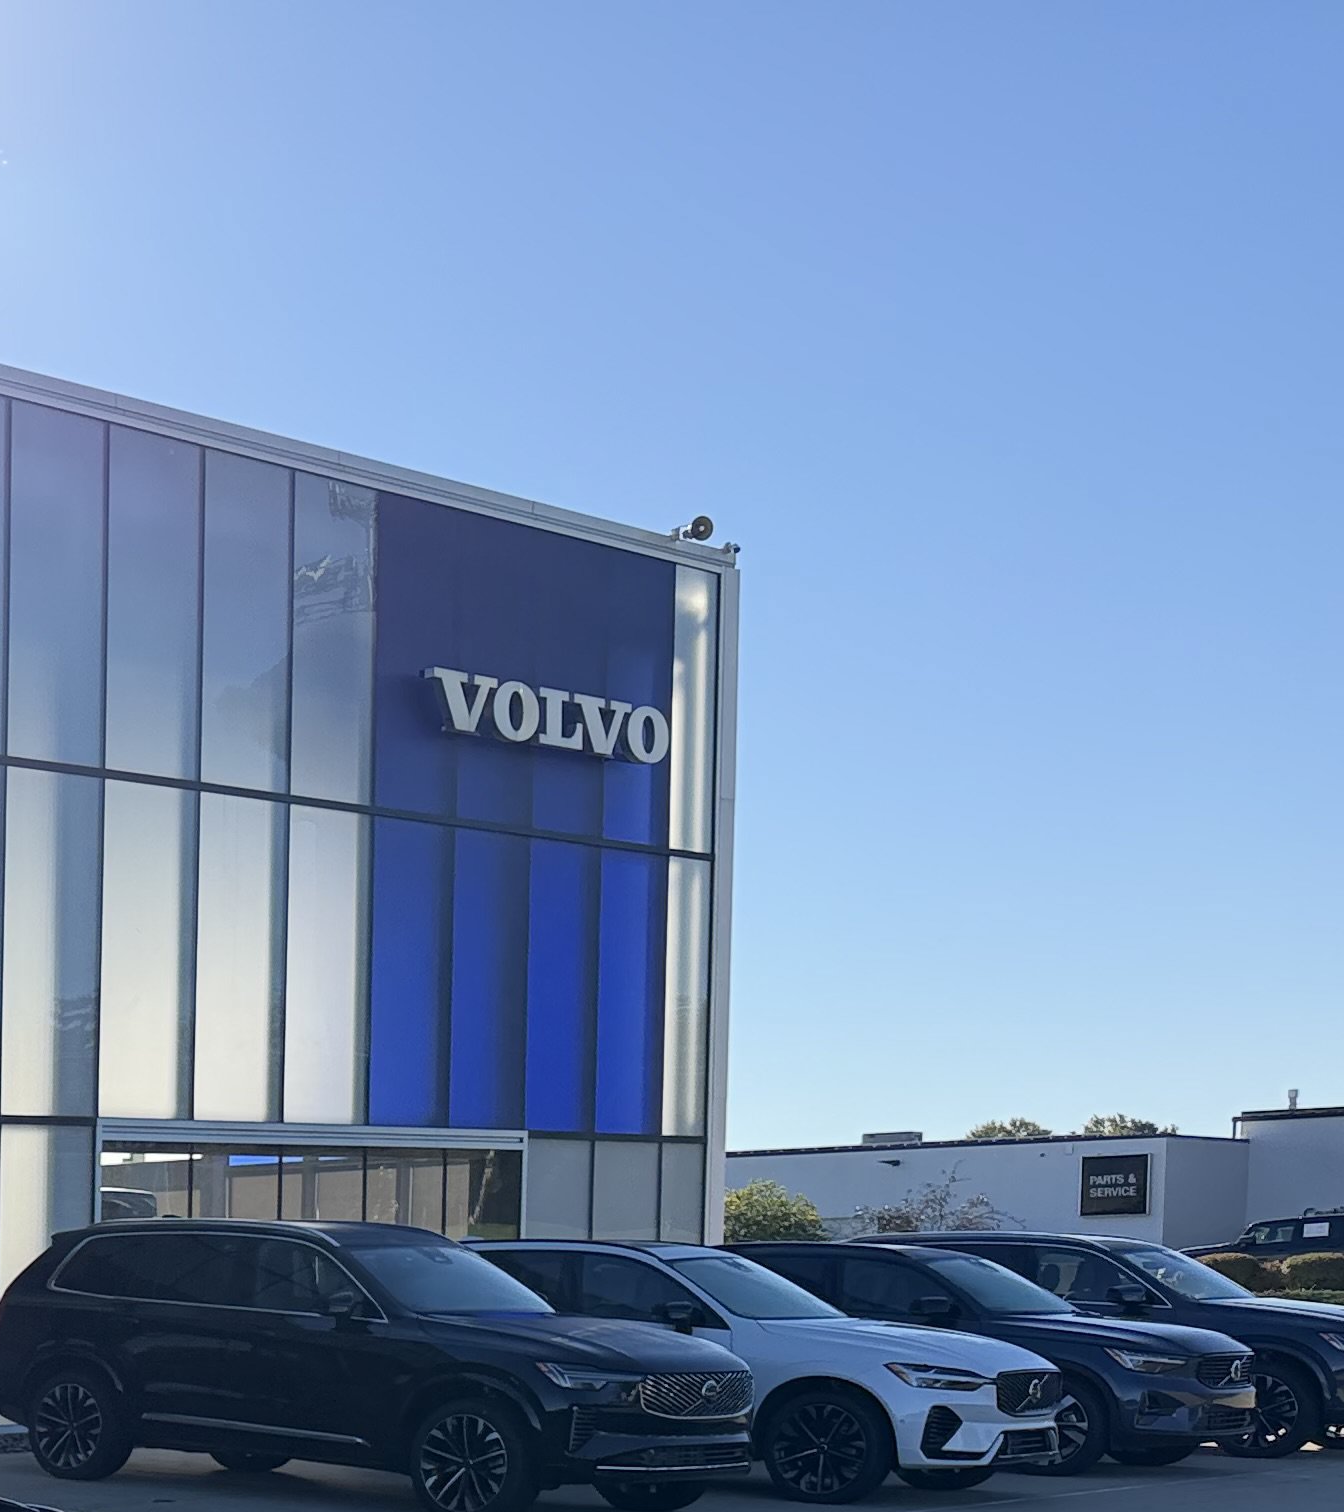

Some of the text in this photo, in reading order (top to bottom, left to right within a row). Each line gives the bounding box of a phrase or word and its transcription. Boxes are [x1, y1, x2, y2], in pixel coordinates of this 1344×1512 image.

[423, 666, 670, 764] VOLVO
[1089, 1173, 1137, 1185] PARTS &
[1089, 1186, 1137, 1198] SERVICE
